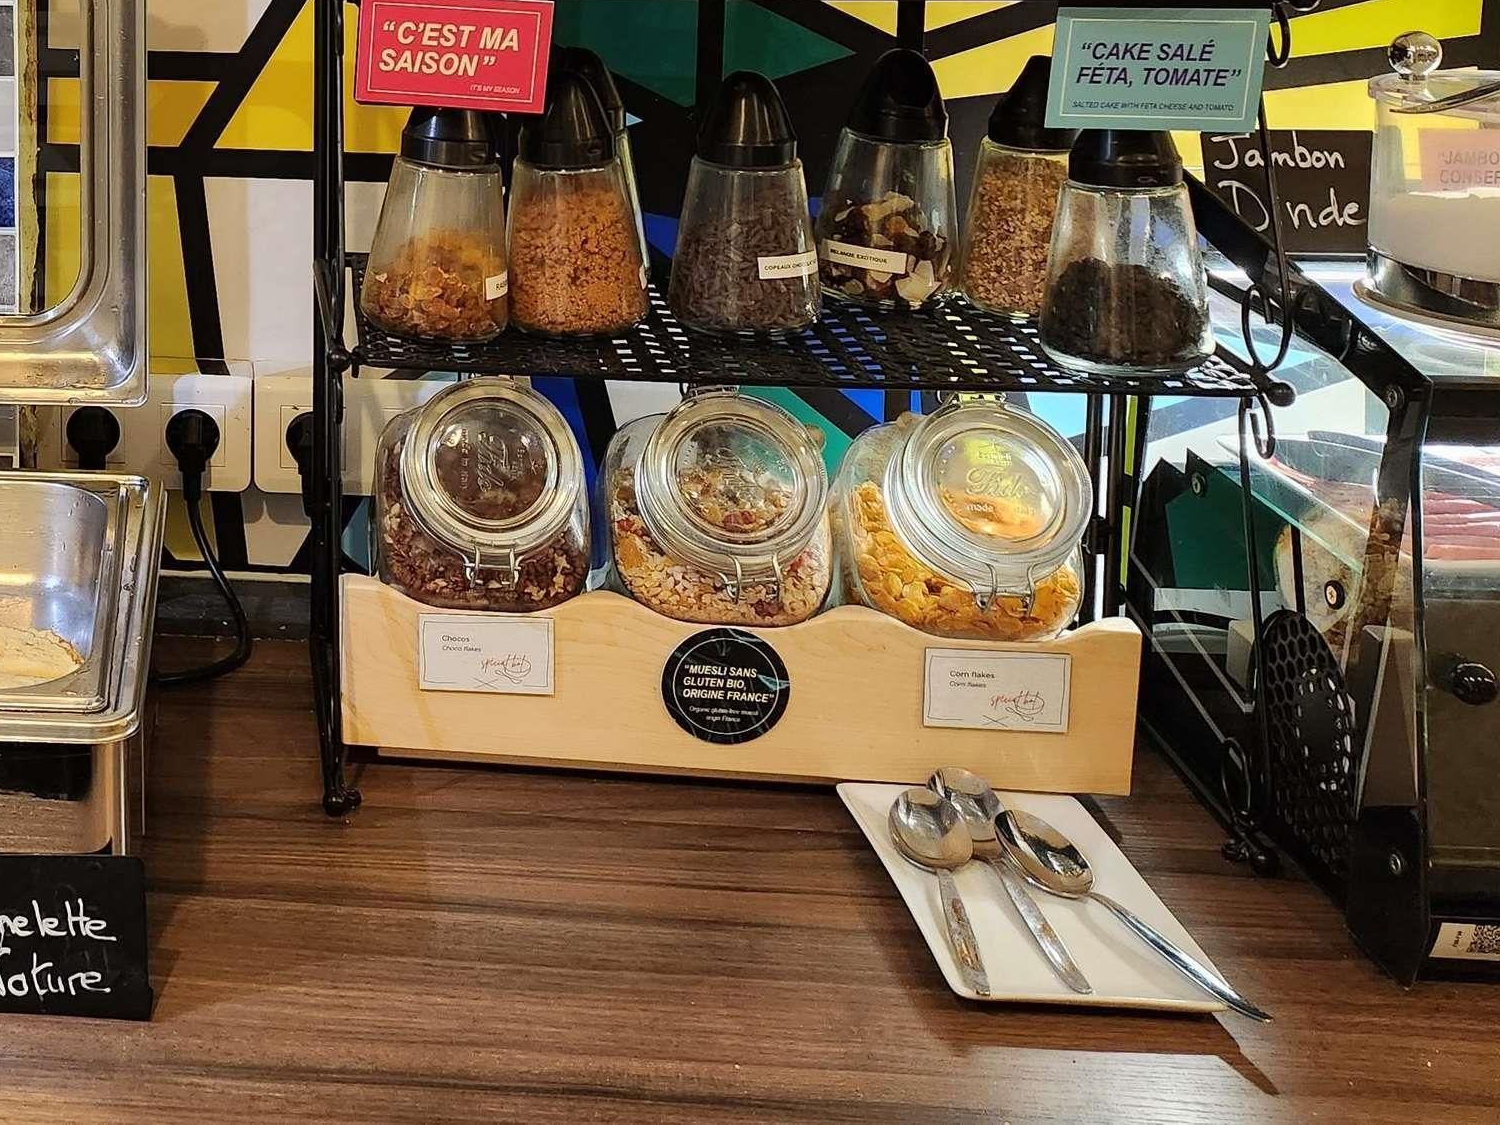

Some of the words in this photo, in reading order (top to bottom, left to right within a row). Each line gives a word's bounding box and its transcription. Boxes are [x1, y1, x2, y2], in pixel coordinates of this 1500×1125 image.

[479, 27, 519, 52] MA
[1157, 40, 1215, 62] SALÉ
[1076, 63, 1133, 87] FÉTA,
[1072, 101, 1099, 109] SALTED
[1100, 101, 1120, 109] CAKE
[1140, 102, 1157, 110] FETA
[1188, 103, 1203, 111] AND
[1205, 103, 1235, 111] TOMATO
[1210, 131, 1345, 170] Jambon
[1217, 180, 1366, 232] Dnde
[442, 634, 470, 643] Chocos
[729, 666, 758, 678] SANS
[949, 670, 969, 678] Corn
[971, 670, 996, 679] flakes
[683, 677, 723, 688] GLUTEN
[726, 678, 747, 690] BIO,
[682, 689, 725, 700] ORIGINE
